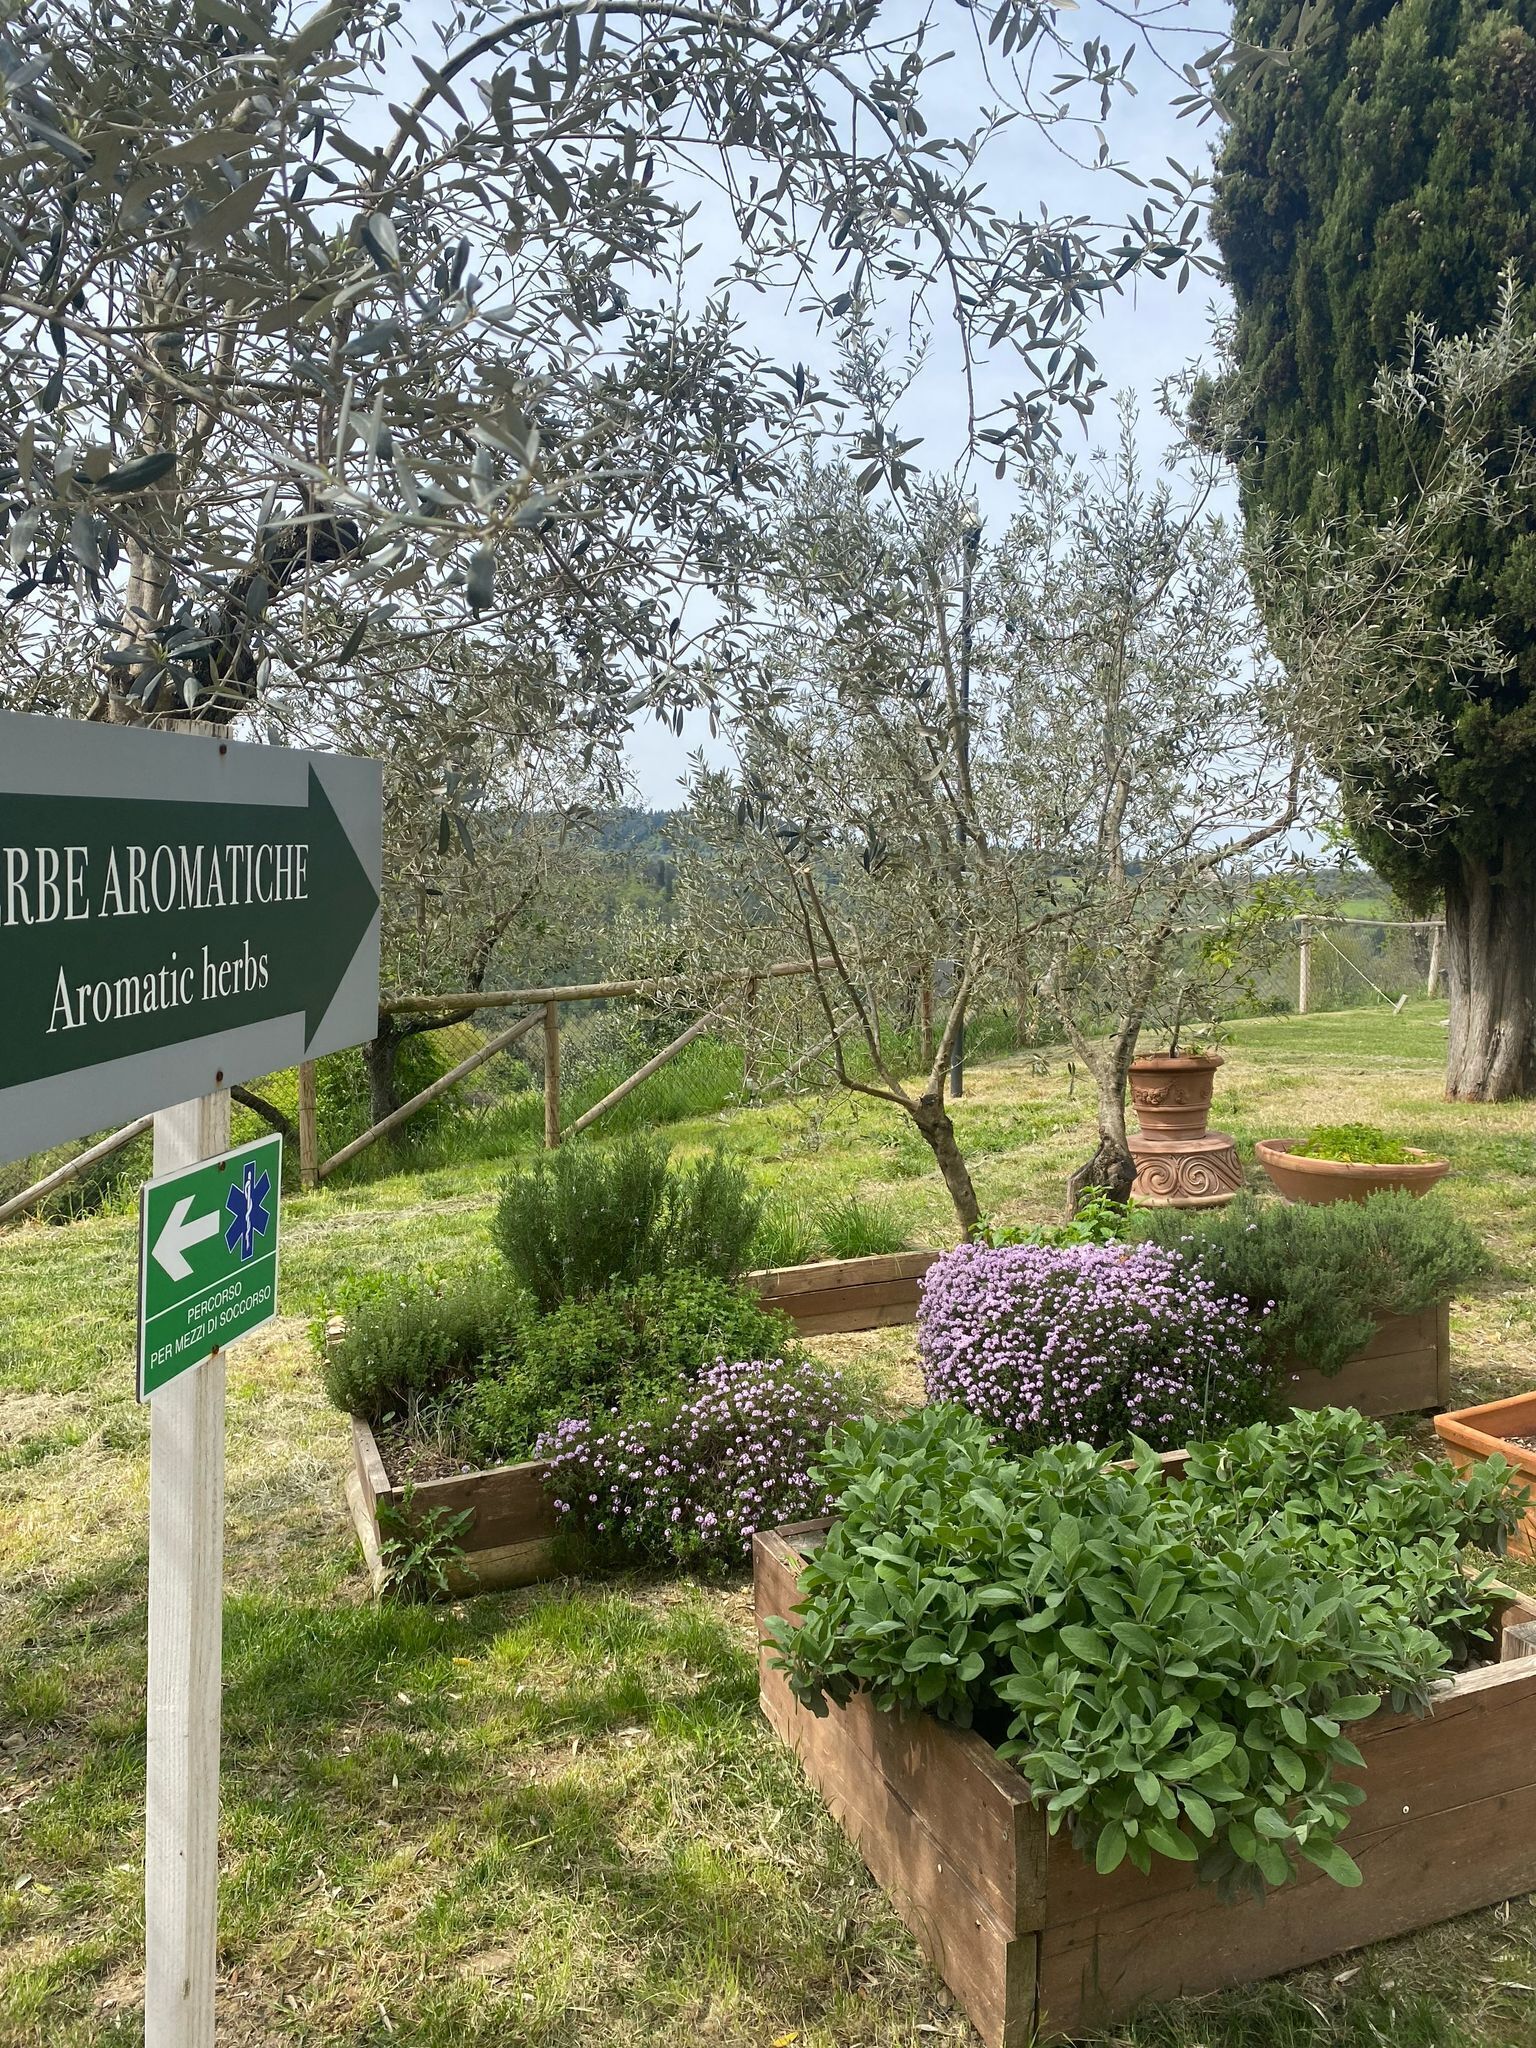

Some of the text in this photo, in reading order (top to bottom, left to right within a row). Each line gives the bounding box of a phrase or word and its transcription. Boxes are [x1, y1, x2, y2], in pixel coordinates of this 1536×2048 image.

[0, 844, 309, 927] RBE AROMATICHE
[45, 940, 269, 1034] Aromatic herbs
[150, 1285, 271, 1370] PER MEZZI DI SOCCORSO
[187, 1281, 242, 1324] PERCORSO
